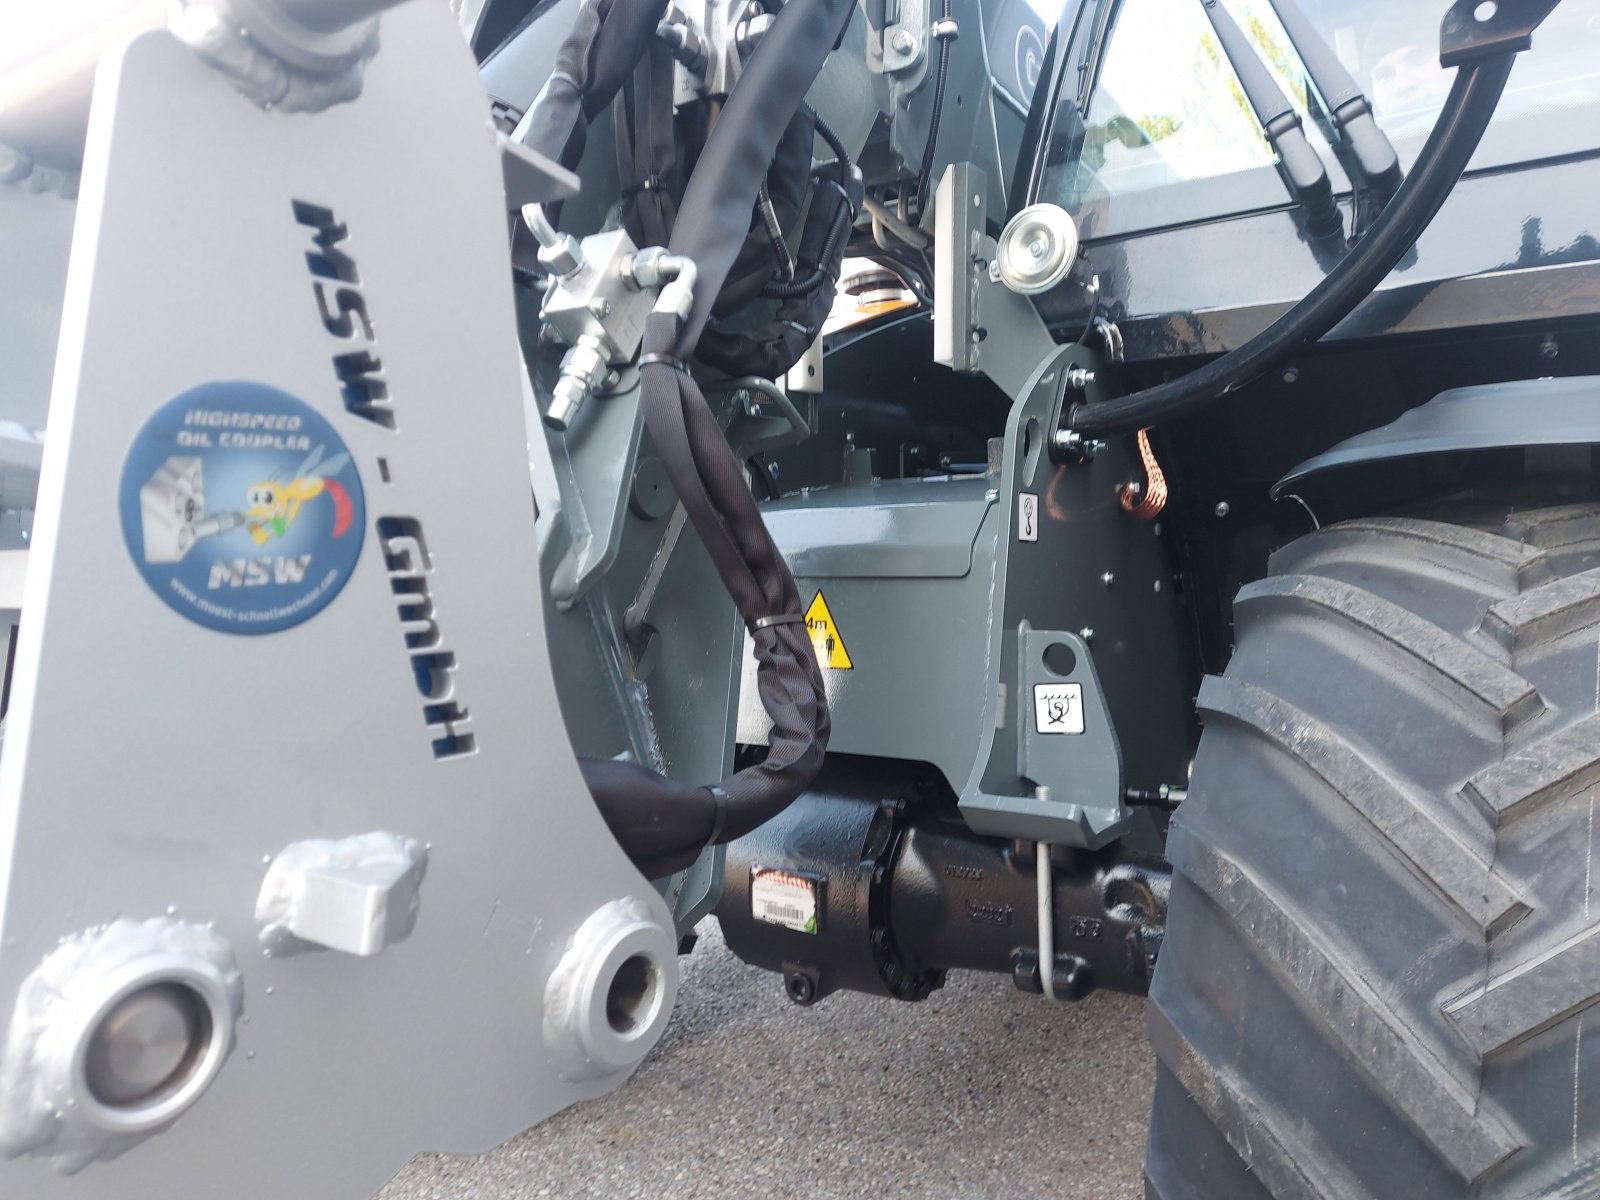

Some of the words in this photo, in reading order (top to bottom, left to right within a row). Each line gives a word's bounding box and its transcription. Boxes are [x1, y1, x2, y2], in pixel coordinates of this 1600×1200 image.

[184, 410, 302, 431] HIGHSPEED
[177, 430, 212, 448] OIL
[219, 431, 310, 451] COUPLER
[292, 199, 400, 431] MSW
[375, 515, 479, 761] GmbH
[208, 554, 313, 590] MSW
[807, 616, 828, 630] 4m
